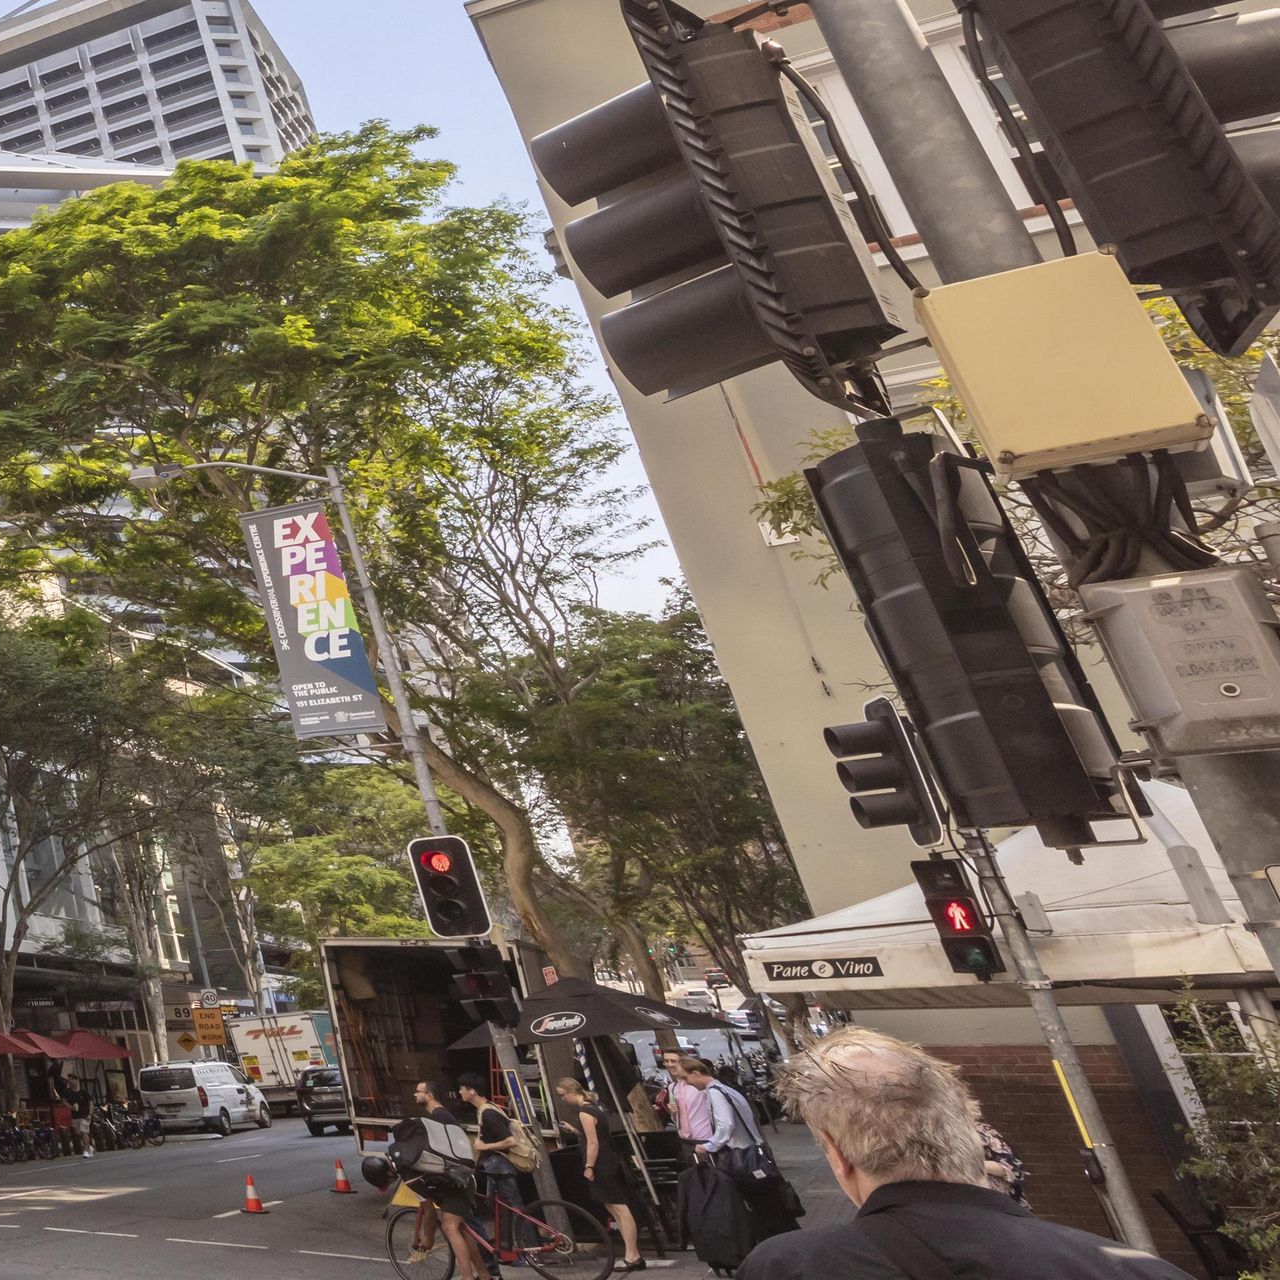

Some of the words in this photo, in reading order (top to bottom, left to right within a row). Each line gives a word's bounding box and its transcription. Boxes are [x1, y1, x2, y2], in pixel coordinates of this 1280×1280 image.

[292, 683, 313, 691] OPEN
[310, 687, 338, 695] PUBLIC
[309, 696, 351, 706] ELIZABETH
[771, 964, 809, 978] Pane
[818, 963, 826, 974] e
[835, 961, 874, 976] Vino
[205, 994, 216, 1002] 40
[174, 1008, 190, 1018] 89
[245, 1025, 304, 1040] TOLL
